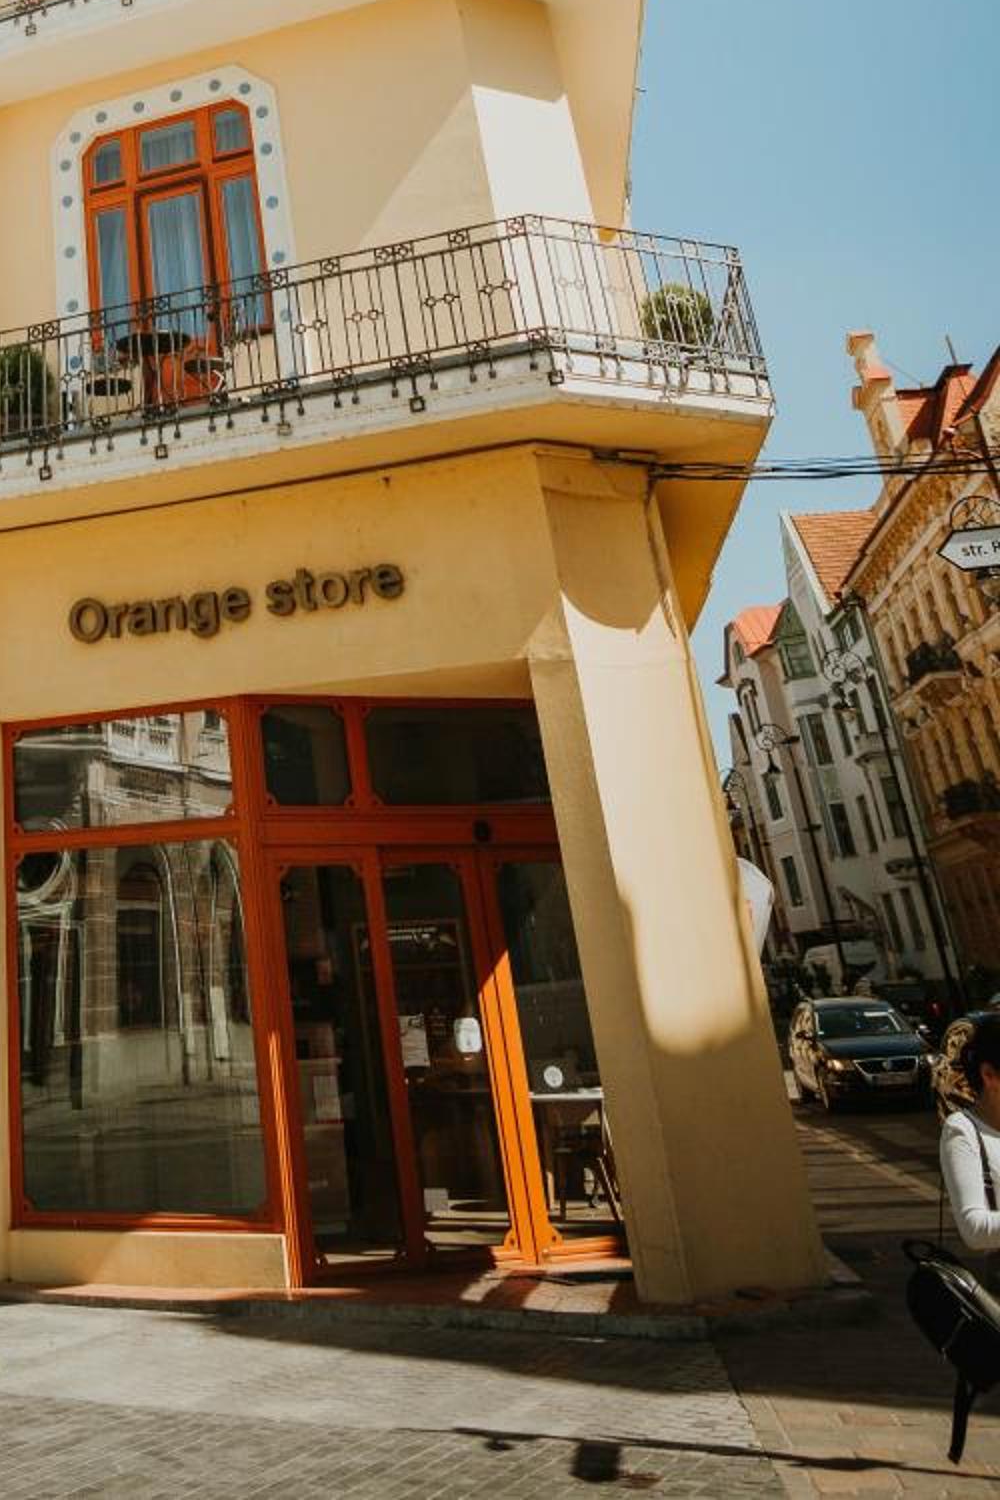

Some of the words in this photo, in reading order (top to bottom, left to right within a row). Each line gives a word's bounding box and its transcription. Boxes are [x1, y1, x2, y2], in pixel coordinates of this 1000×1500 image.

[961, 544, 989, 557] str.
[68, 586, 251, 644] Orange
[265, 563, 406, 617] store
